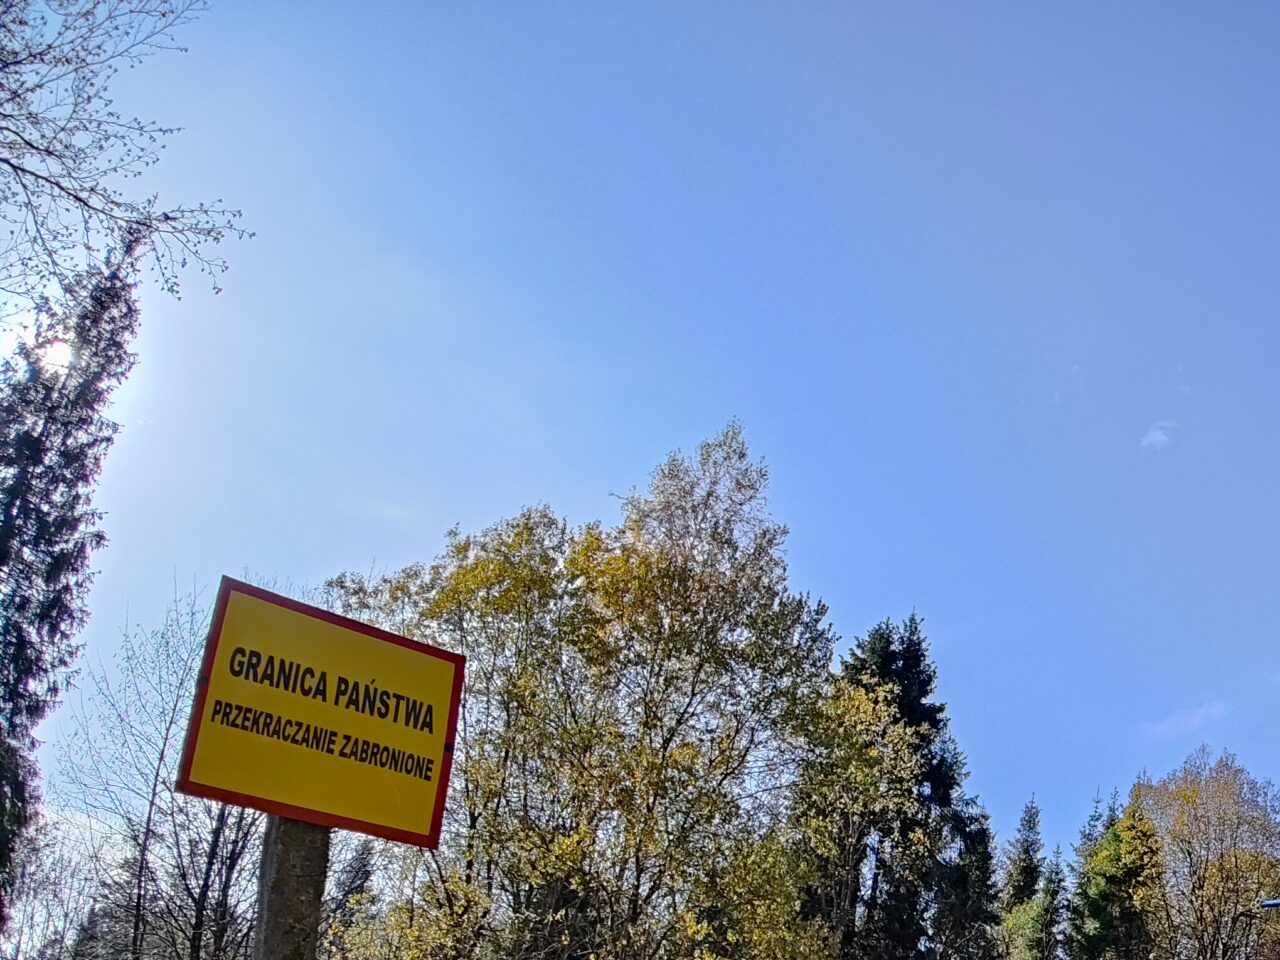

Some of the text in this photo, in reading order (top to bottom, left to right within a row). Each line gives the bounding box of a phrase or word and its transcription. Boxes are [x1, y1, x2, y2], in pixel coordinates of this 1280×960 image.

[229, 647, 434, 735] GRANICA PAŃSTWA
[211, 700, 434, 782] PRZEKRACZANIE ZABRONIONE
